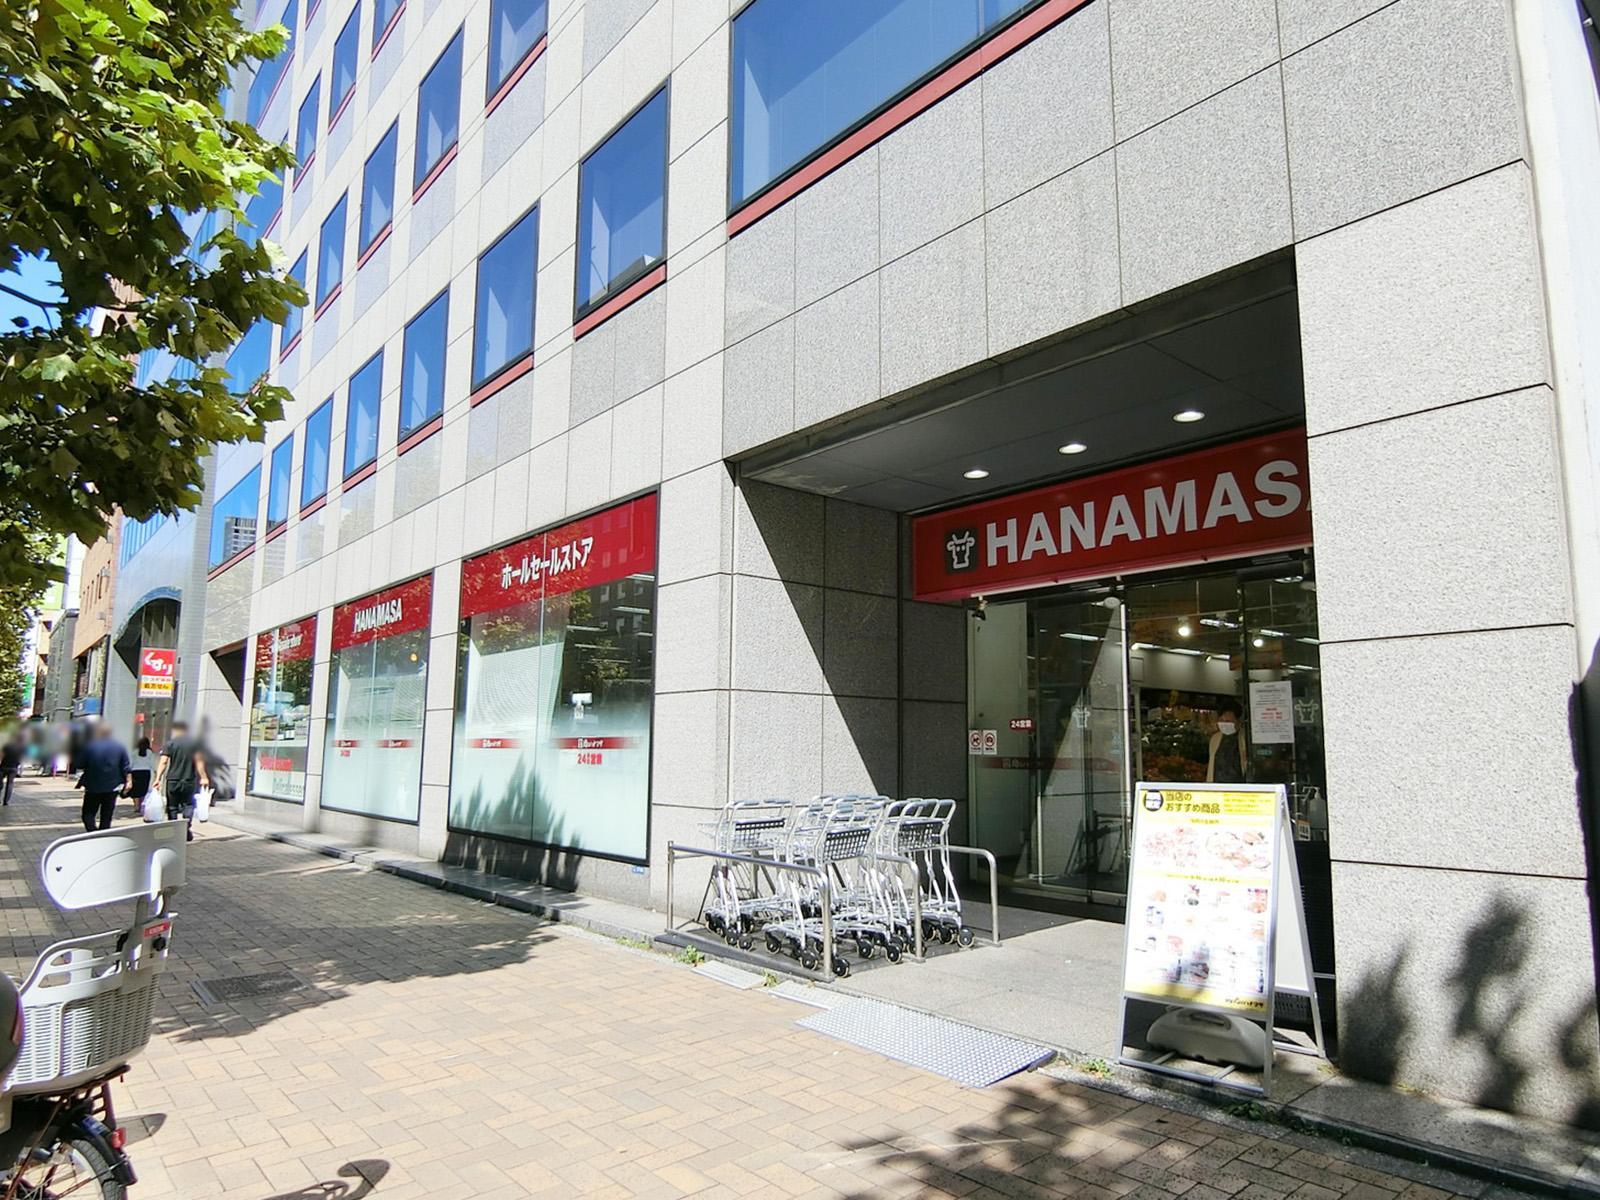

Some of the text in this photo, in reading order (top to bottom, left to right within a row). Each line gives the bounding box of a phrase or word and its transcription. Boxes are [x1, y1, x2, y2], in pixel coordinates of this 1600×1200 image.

[986, 460, 1312, 567] HANAMAS
[502, 537, 593, 589] ホールセールストア
[354, 598, 402, 633] HANAMASA
[144, 652, 173, 675] くすり
[1165, 791, 1193, 802] 当店の
[1165, 802, 1221, 814] おすすめ商品
